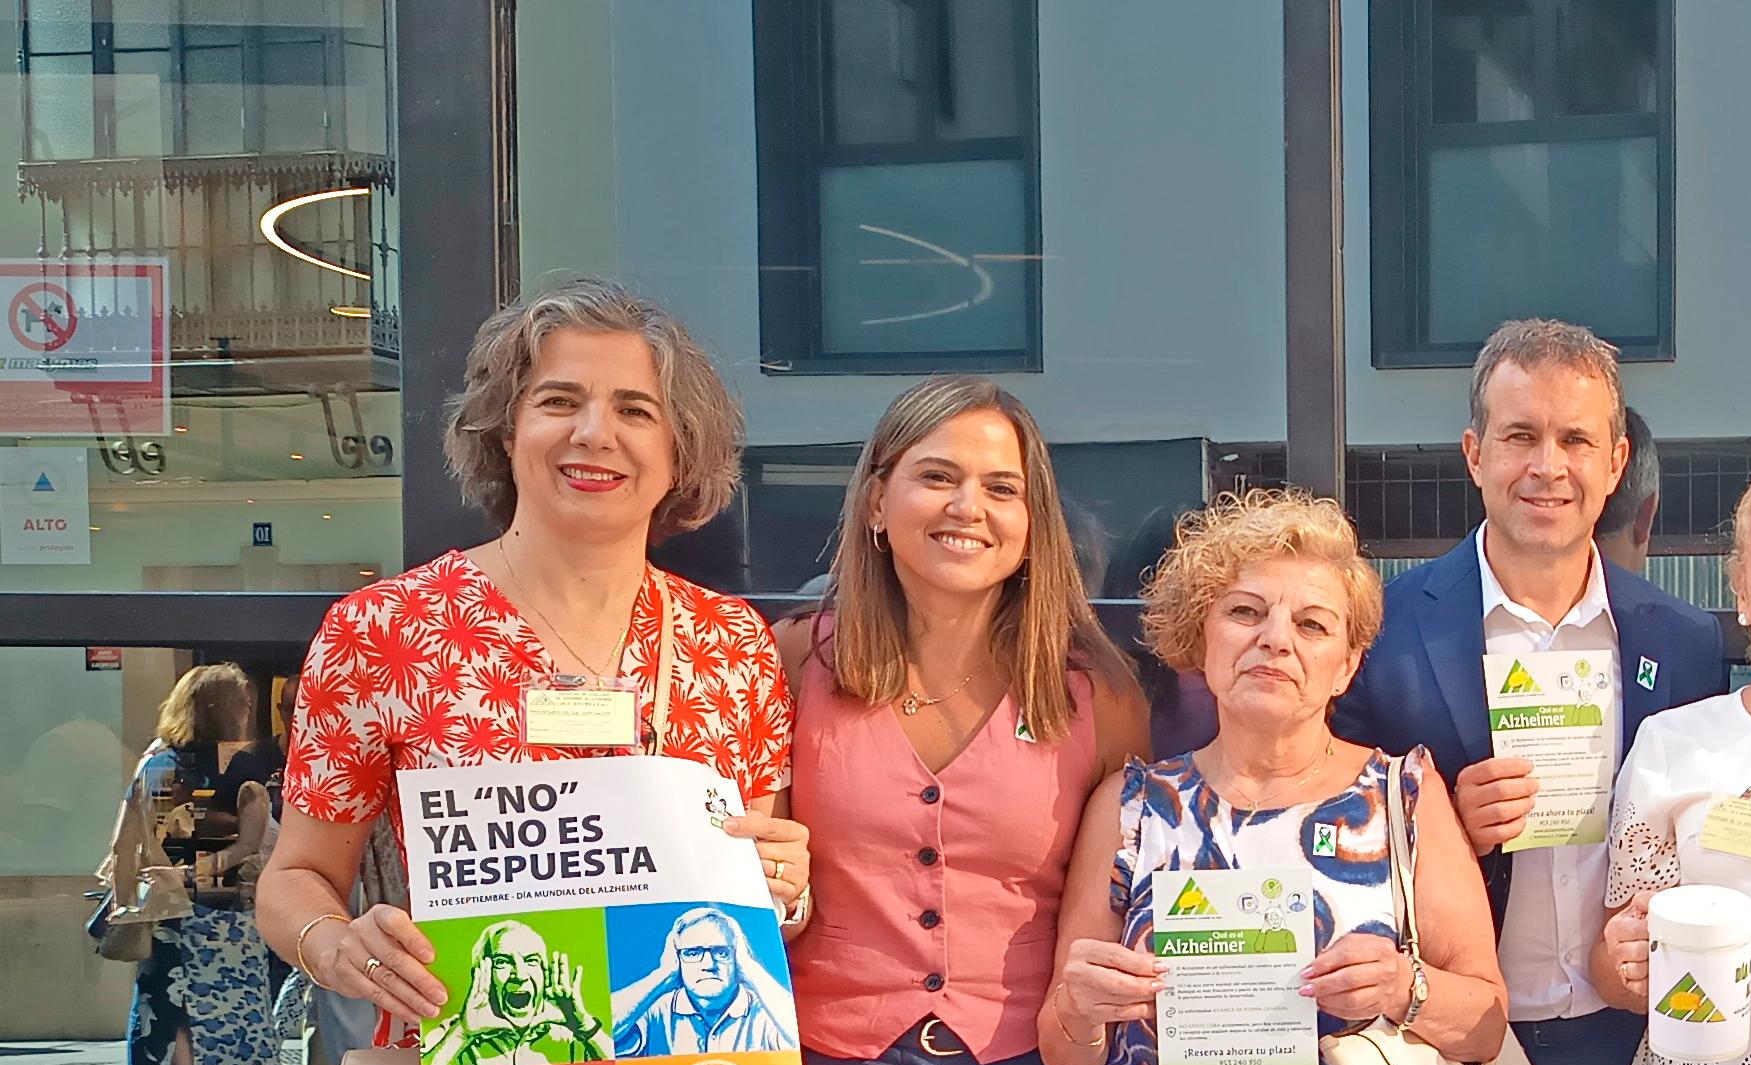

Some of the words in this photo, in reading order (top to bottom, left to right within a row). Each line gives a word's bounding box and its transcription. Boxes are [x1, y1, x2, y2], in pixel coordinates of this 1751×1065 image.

[23, 519, 67, 531] ALTO
[1498, 713, 1565, 728] Alzheimer
[420, 790, 467, 819] EL
[423, 824, 476, 855] YA
[487, 818, 546, 850] NO
[558, 815, 603, 845] ES
[428, 847, 657, 890] RESPUESTA
[442, 898, 453, 906] DE
[455, 893, 510, 905] SEPTIEMBRE
[516, 890, 532, 900] DÍA
[535, 888, 576, 898] MUNDIAL
[579, 886, 596, 895] DEL
[598, 883, 649, 894] ALZHEIMER
[1162, 937, 1245, 955] Alzheimer
[1184, 1048, 1224, 1059] ¡Reserva
[1227, 1047, 1253, 1056] ahora
[1269, 1046, 1296, 1056] plaza!
